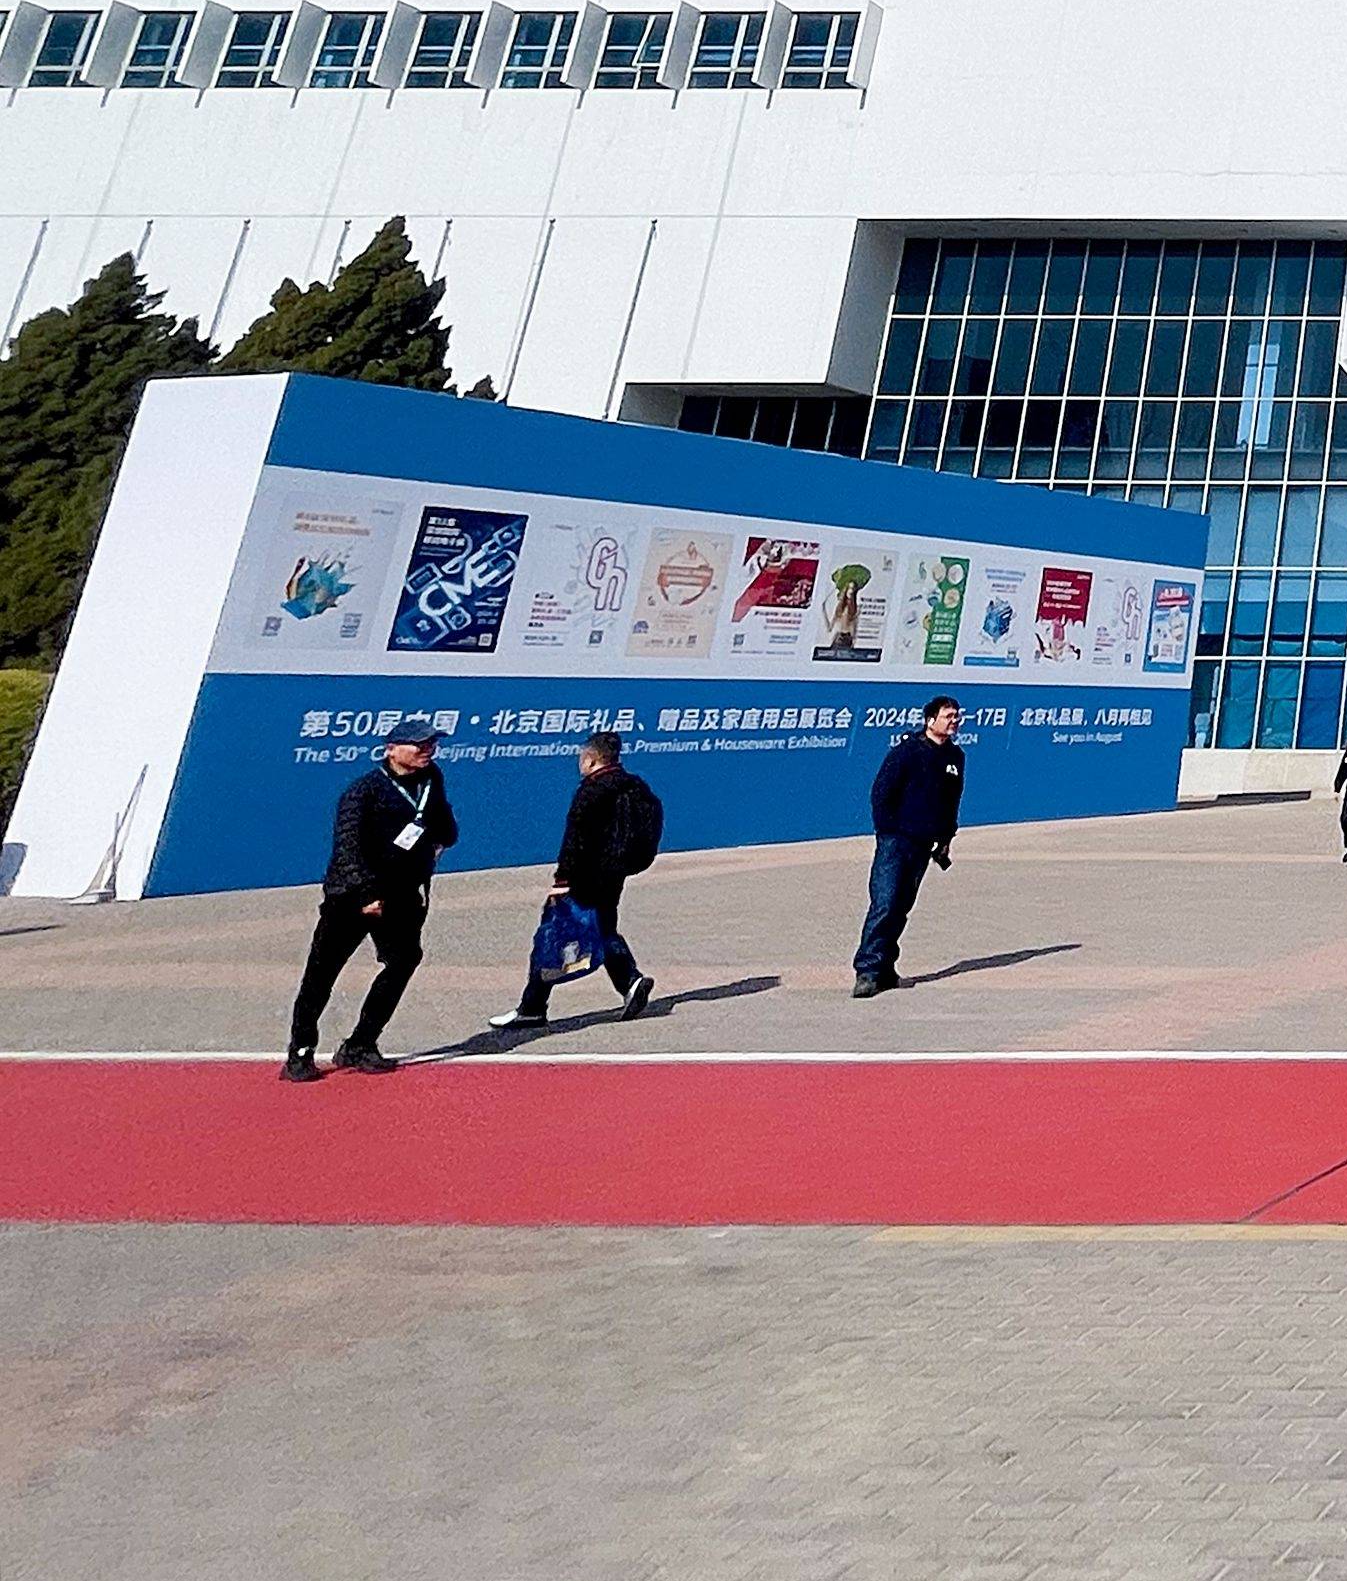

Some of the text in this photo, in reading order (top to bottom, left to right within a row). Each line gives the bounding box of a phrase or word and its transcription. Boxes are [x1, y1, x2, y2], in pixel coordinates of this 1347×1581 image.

[293, 746, 330, 764] The
[713, 736, 786, 752] Houseware
[787, 734, 848, 750] Exhibition
